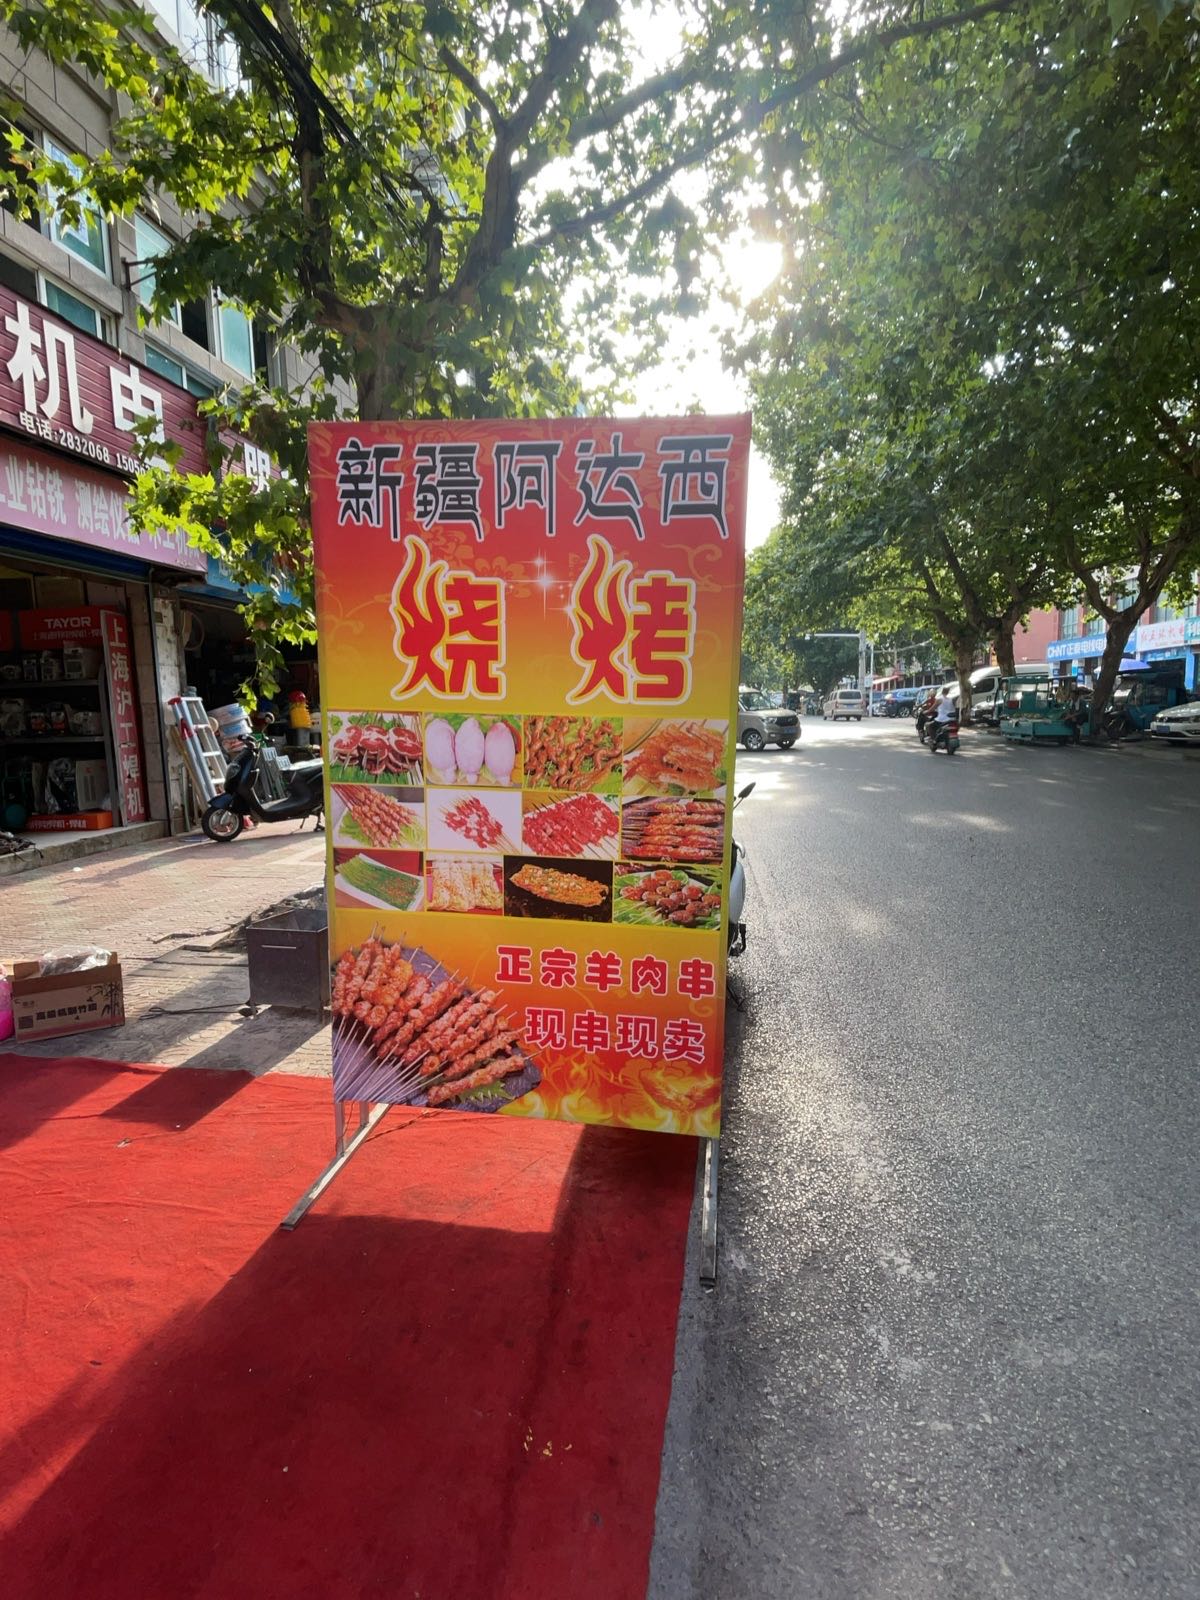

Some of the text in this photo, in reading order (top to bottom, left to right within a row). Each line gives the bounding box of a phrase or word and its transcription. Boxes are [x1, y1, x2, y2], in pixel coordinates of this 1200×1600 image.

[0, 454, 67, 525] 业钻铣
[336, 432, 734, 542] 新疆阿达西
[44, 616, 91, 629] TAYOR
[388, 533, 697, 705] 烧烤
[109, 618, 144, 817] 上海沪工焊机
[495, 944, 717, 999] 正宗羊肉串
[523, 1006, 707, 1064] 现串现卖
